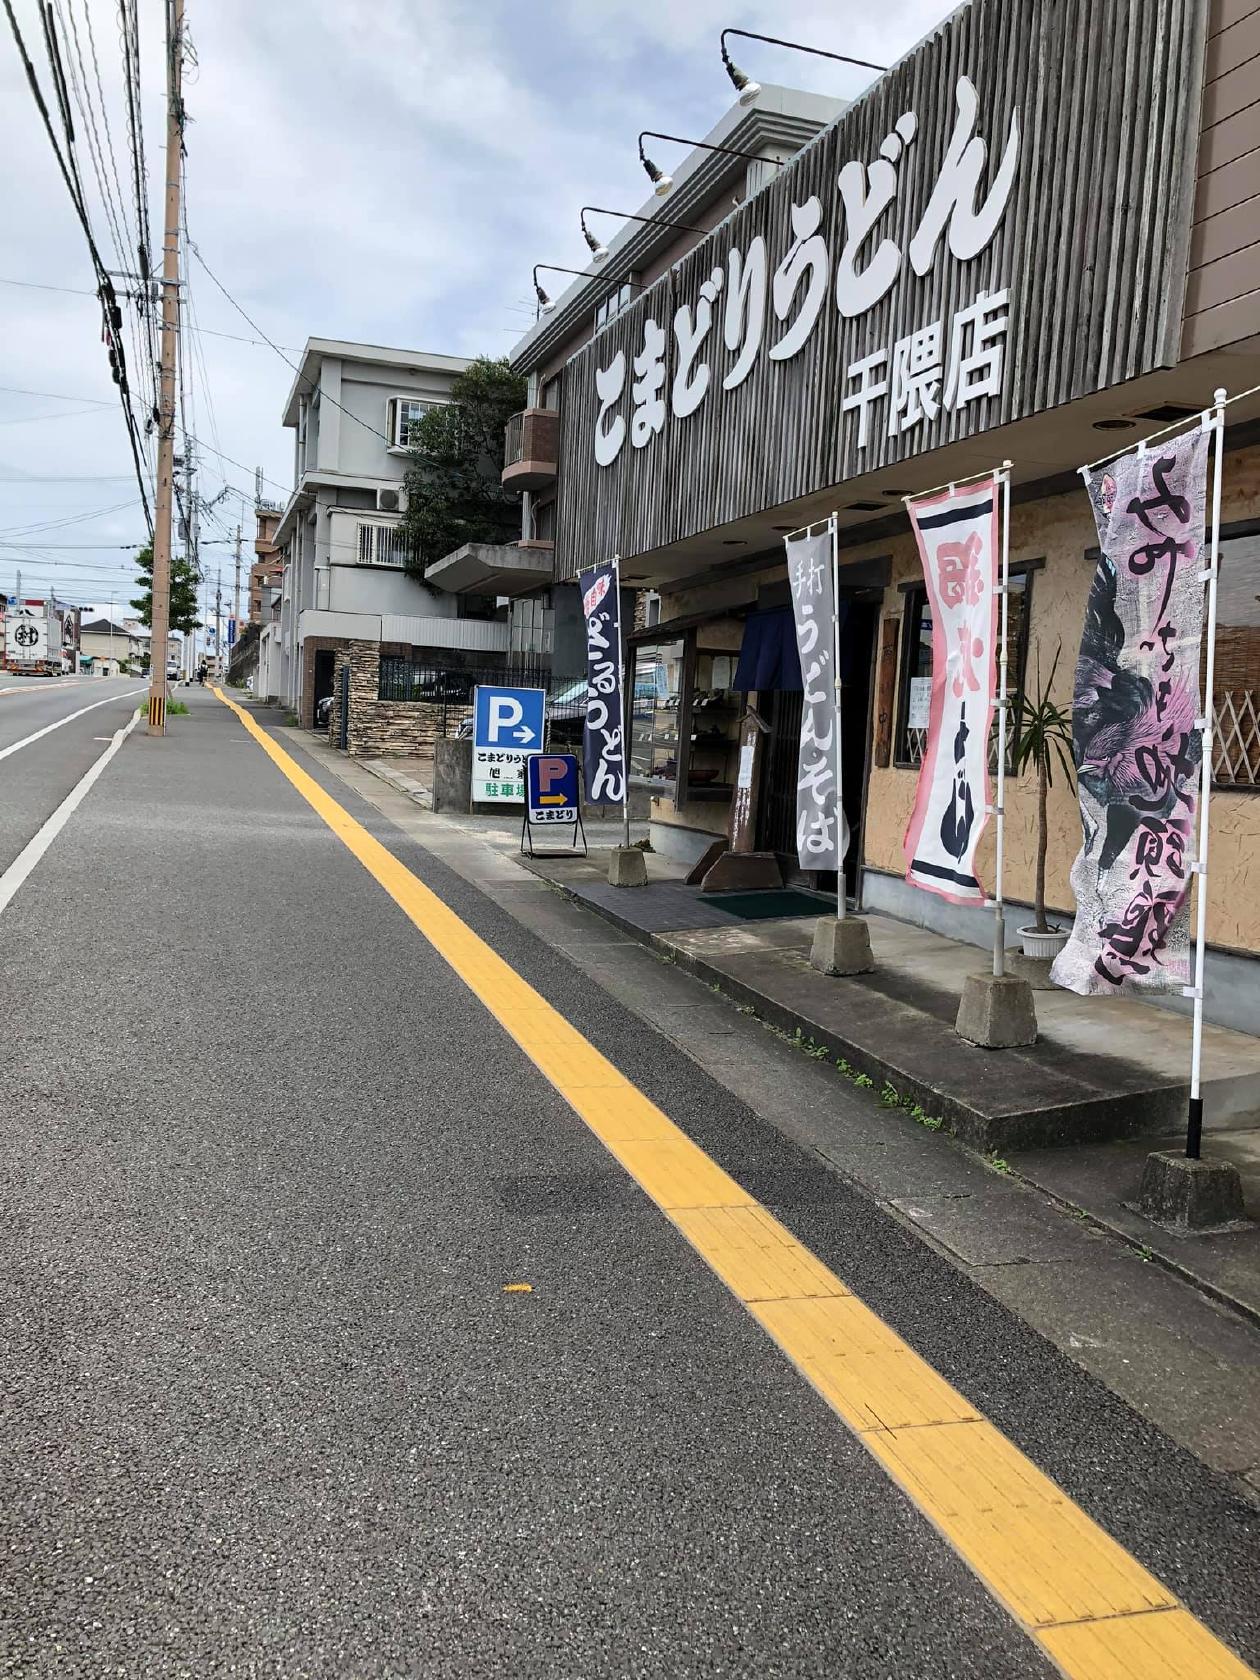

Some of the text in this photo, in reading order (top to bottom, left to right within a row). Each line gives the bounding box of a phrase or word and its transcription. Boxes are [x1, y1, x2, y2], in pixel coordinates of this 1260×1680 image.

[595, 75, 1021, 467] こまどりうどん
[844, 287, 1011, 449] 干隈店
[488, 696, 523, 742] P
[538, 758, 569, 792] P
[535, 809, 573, 821] こまどり
